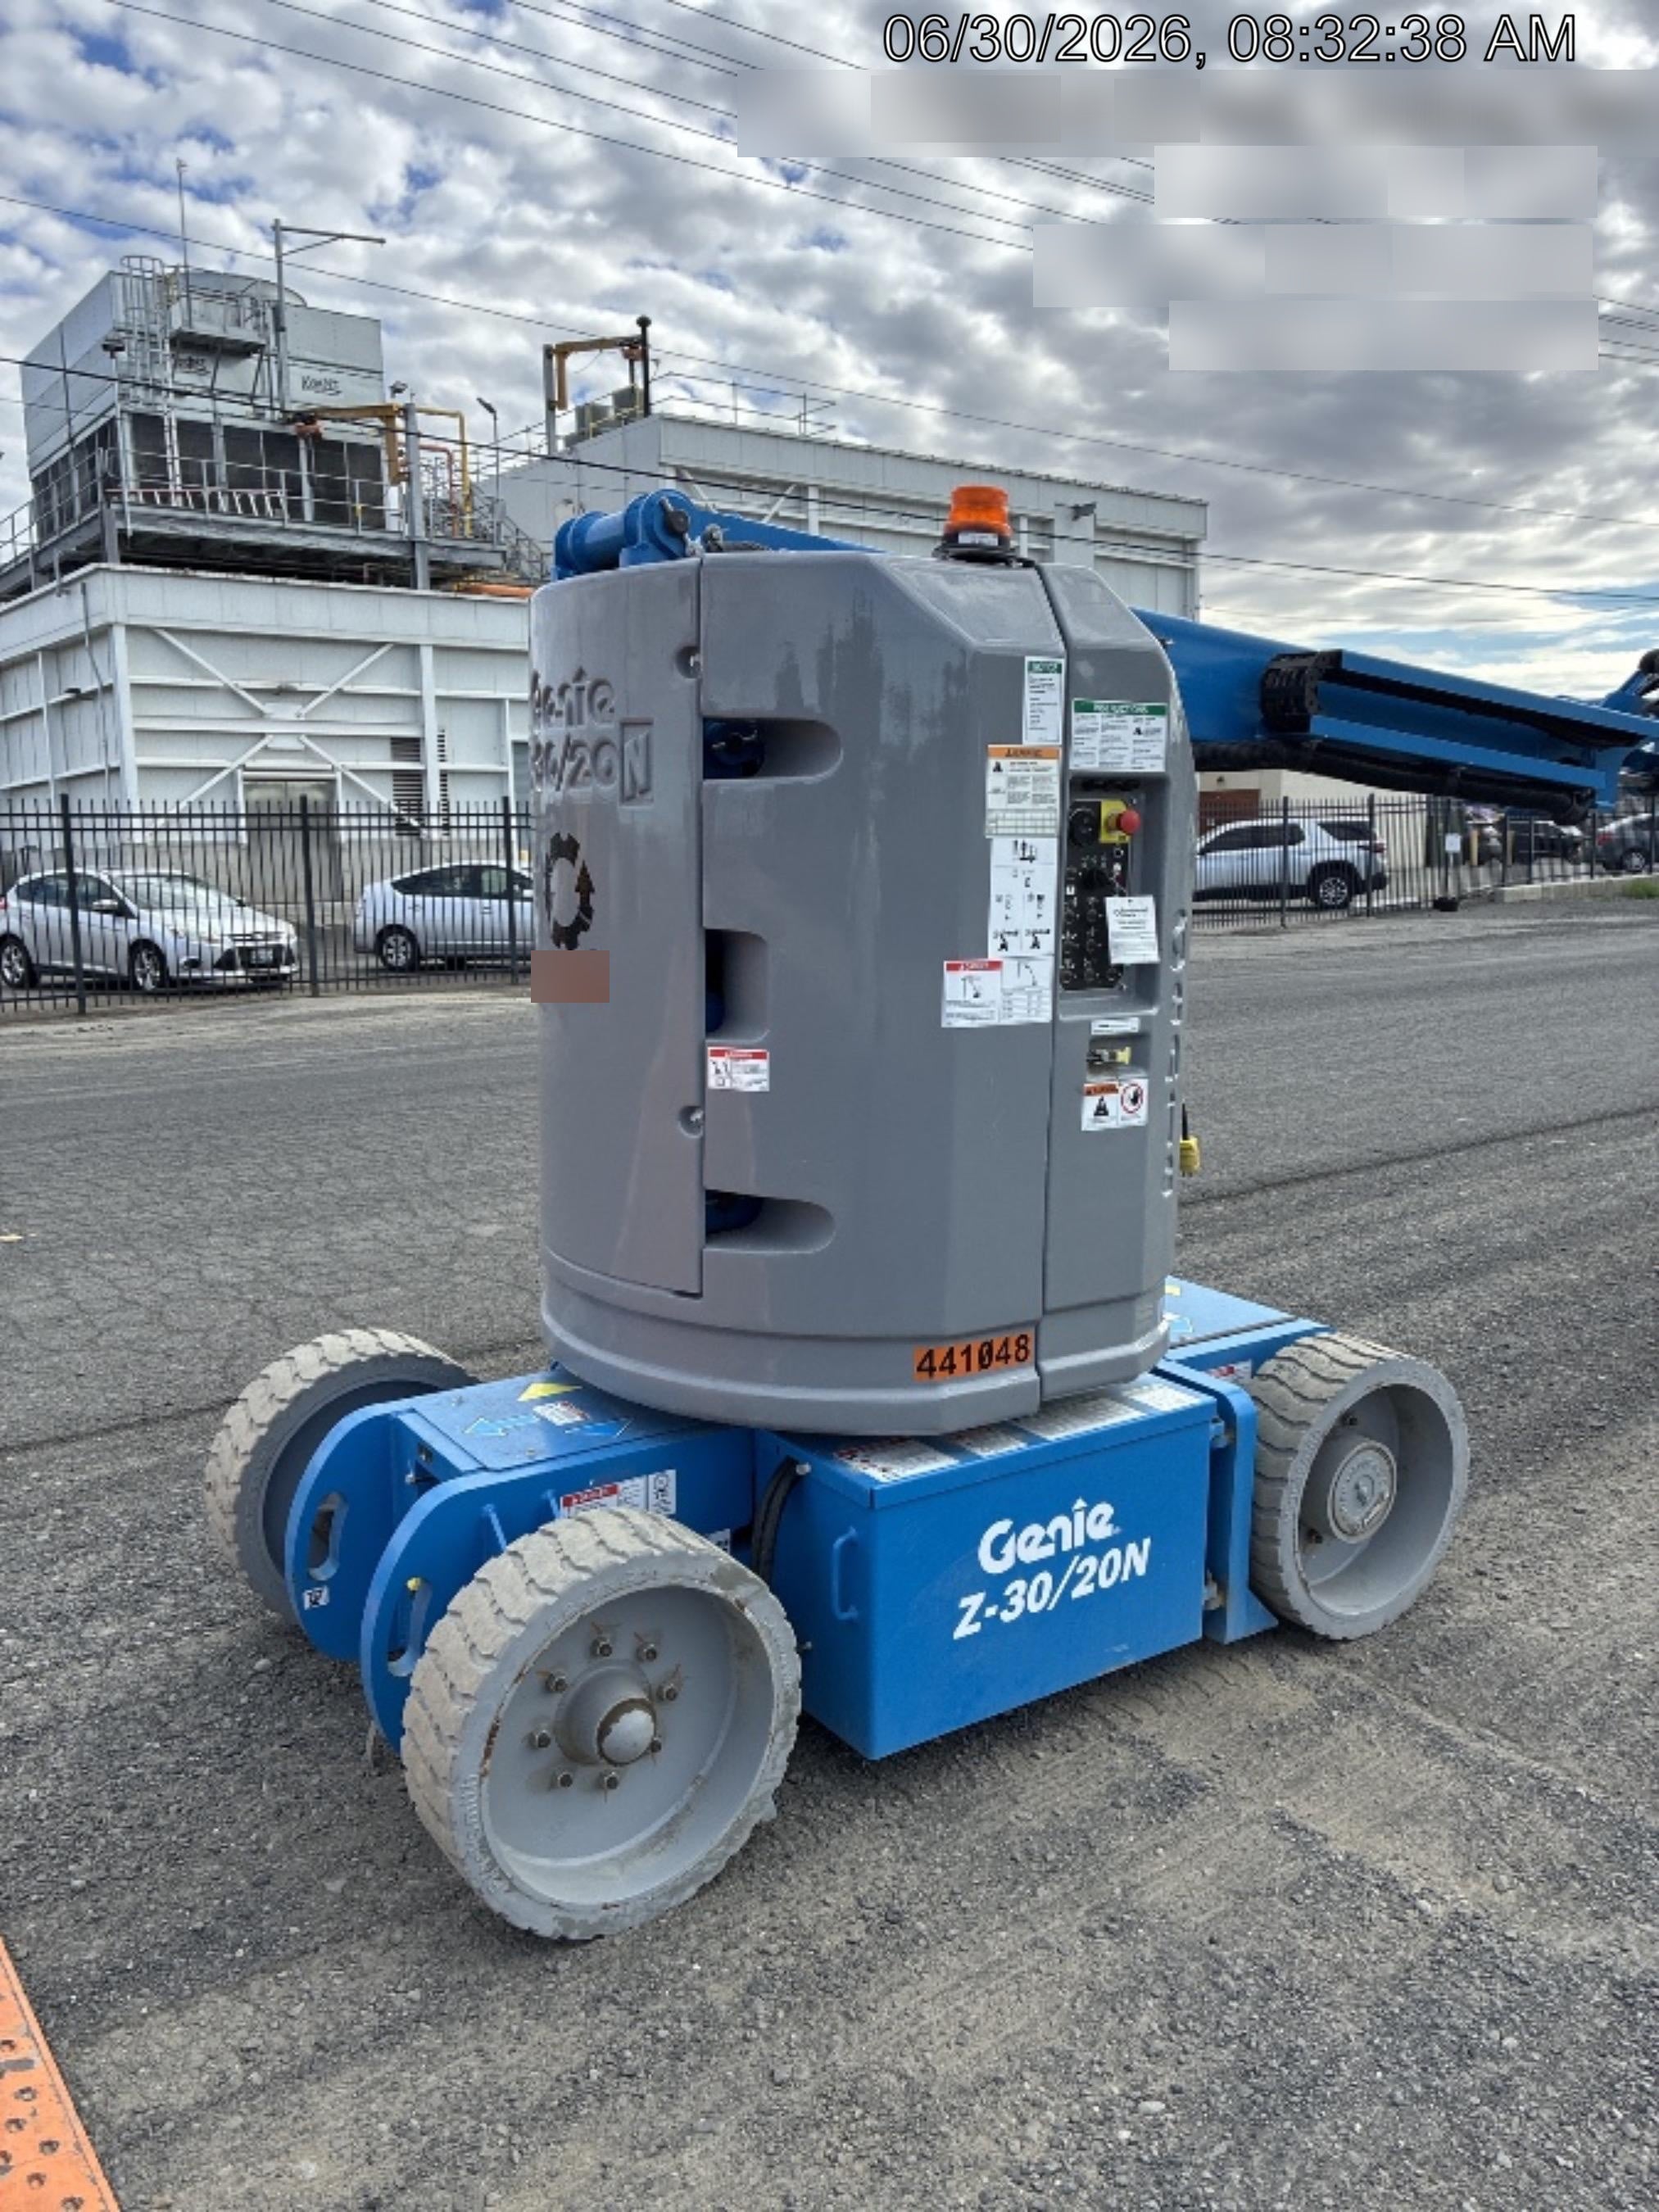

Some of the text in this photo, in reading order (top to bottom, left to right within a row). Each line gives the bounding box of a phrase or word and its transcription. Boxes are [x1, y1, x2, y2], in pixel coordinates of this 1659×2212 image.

[916, 1333, 1031, 1379] 441048
[977, 1496, 1116, 1574] Genie
[953, 1535, 1151, 1640] Z-30/20N
